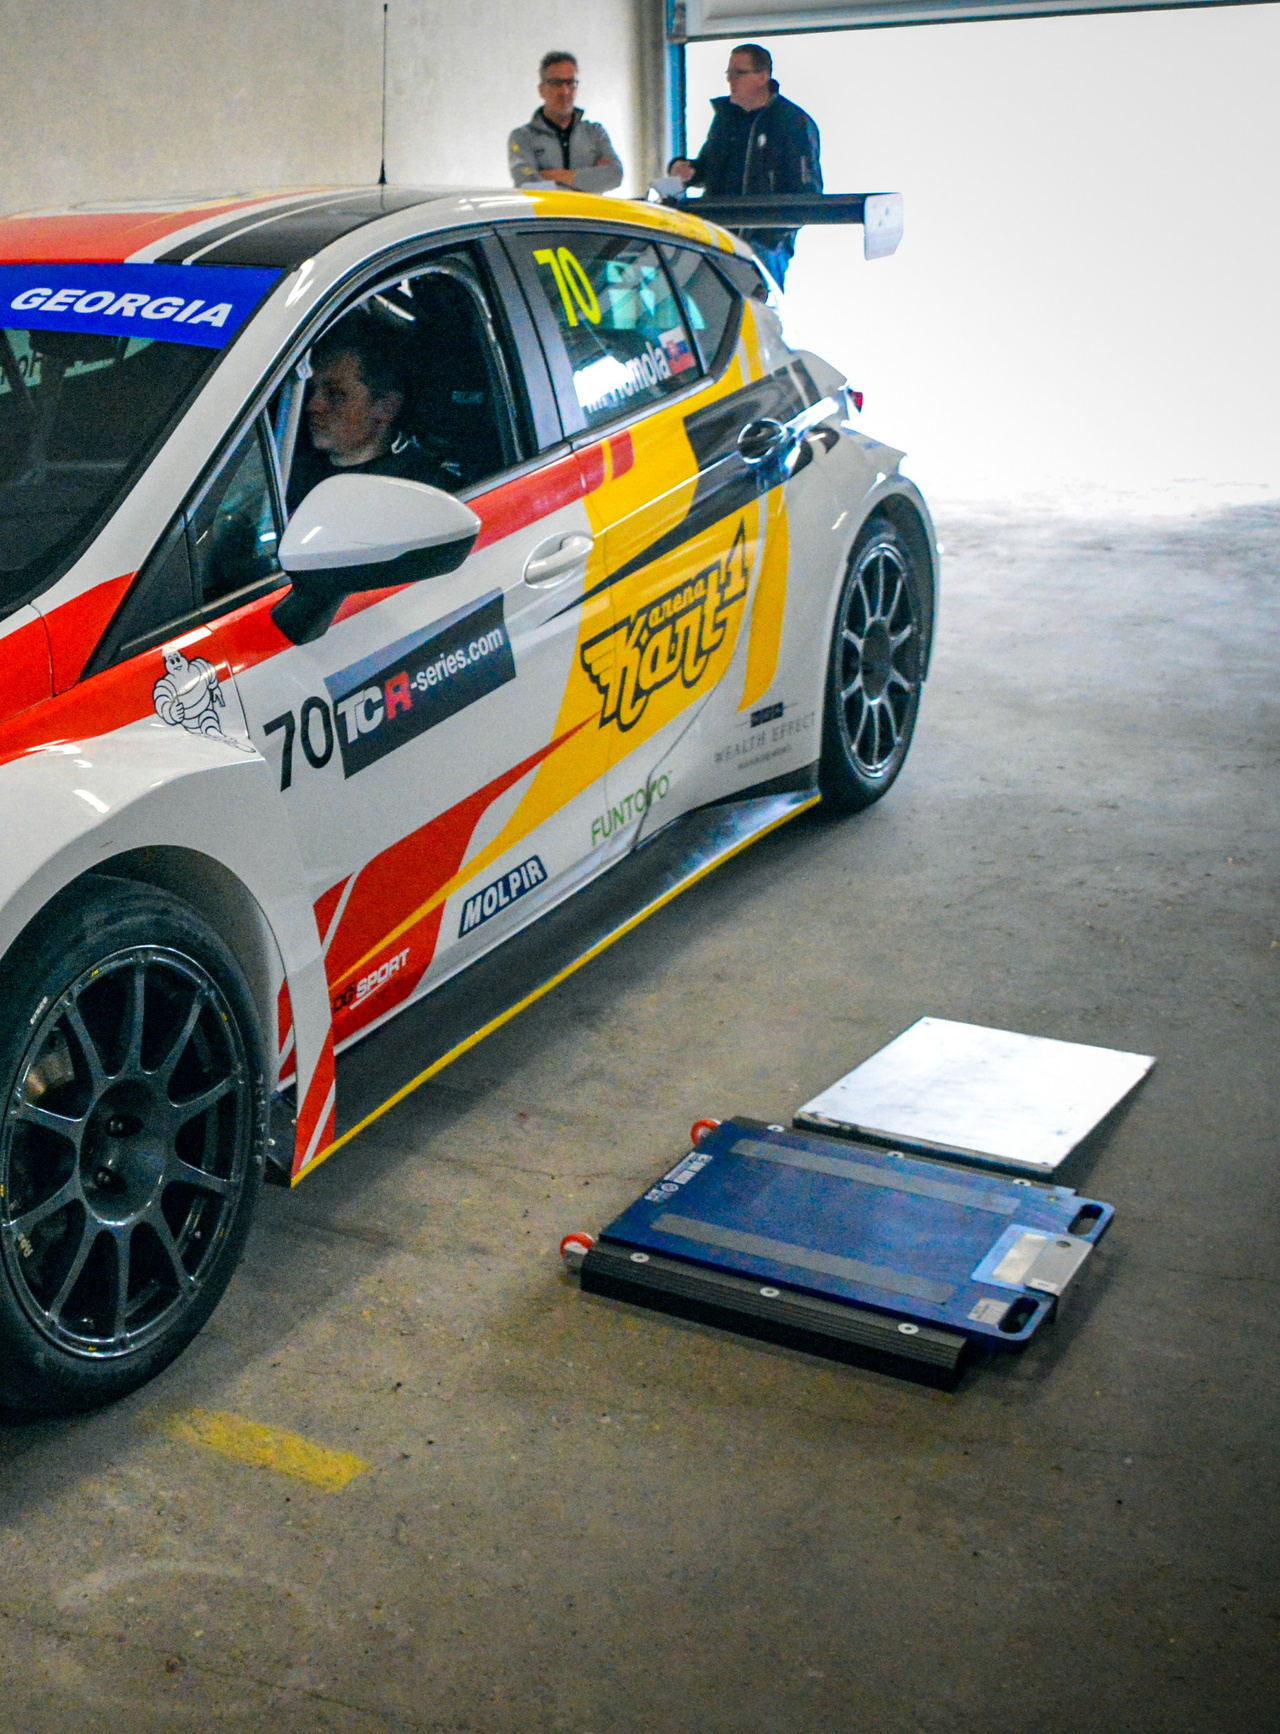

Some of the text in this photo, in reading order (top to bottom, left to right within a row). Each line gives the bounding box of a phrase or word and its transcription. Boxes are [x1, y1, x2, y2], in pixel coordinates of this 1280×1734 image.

[10, 288, 234, 328] GEORGIA
[532, 246, 602, 327] 70
[262, 696, 334, 792] 70
[463, 859, 545, 932] MOLPIR
[355, 948, 410, 999] SPORT
